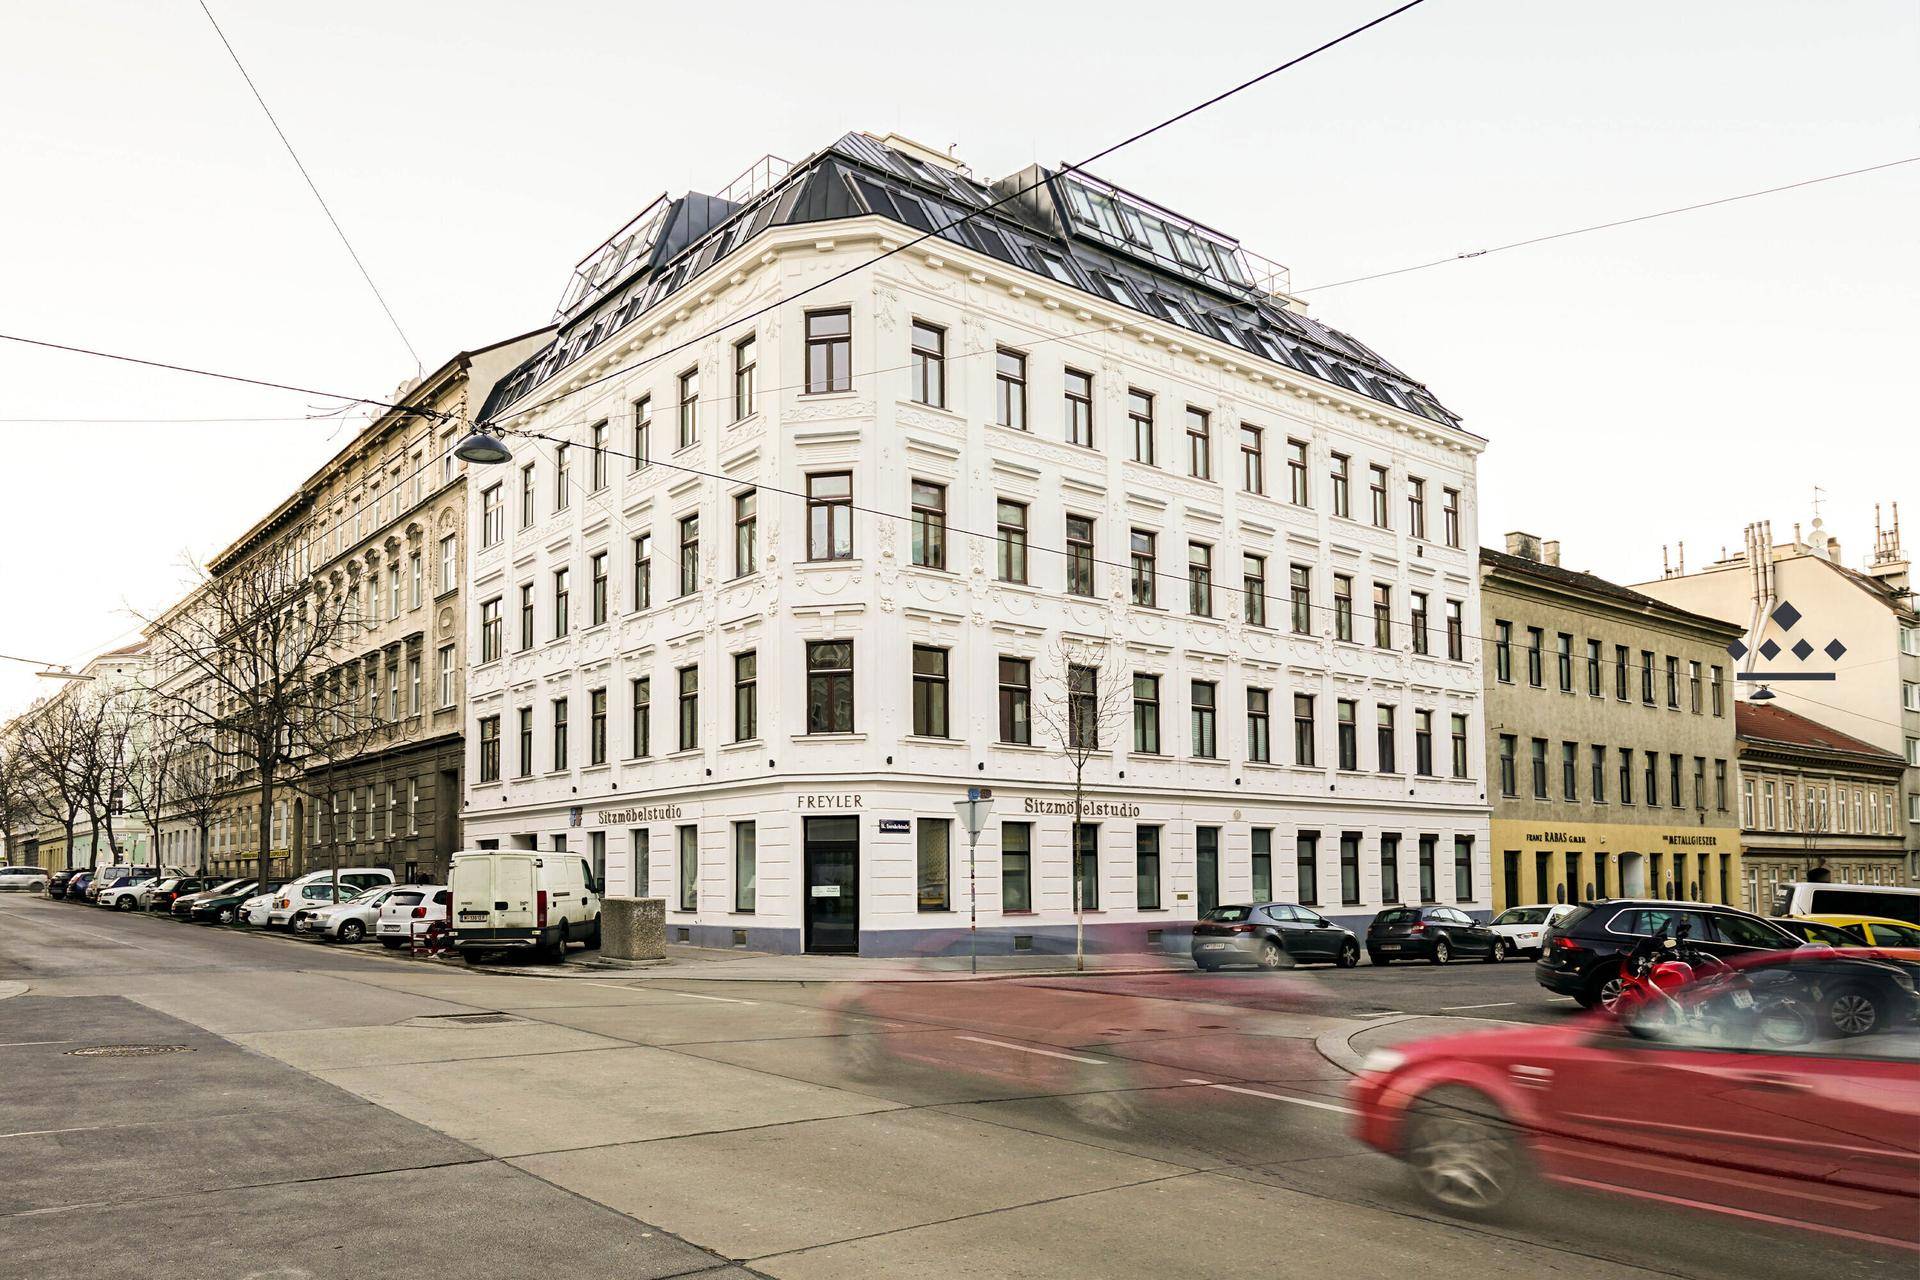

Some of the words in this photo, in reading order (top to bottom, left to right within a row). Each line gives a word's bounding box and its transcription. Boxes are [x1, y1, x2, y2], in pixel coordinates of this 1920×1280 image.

[797, 795, 863, 808] FREYLER
[598, 804, 682, 825] Sitzmöbelstudio
[1526, 833, 1543, 842] FRANZ
[1544, 832, 1568, 843] RABAS
